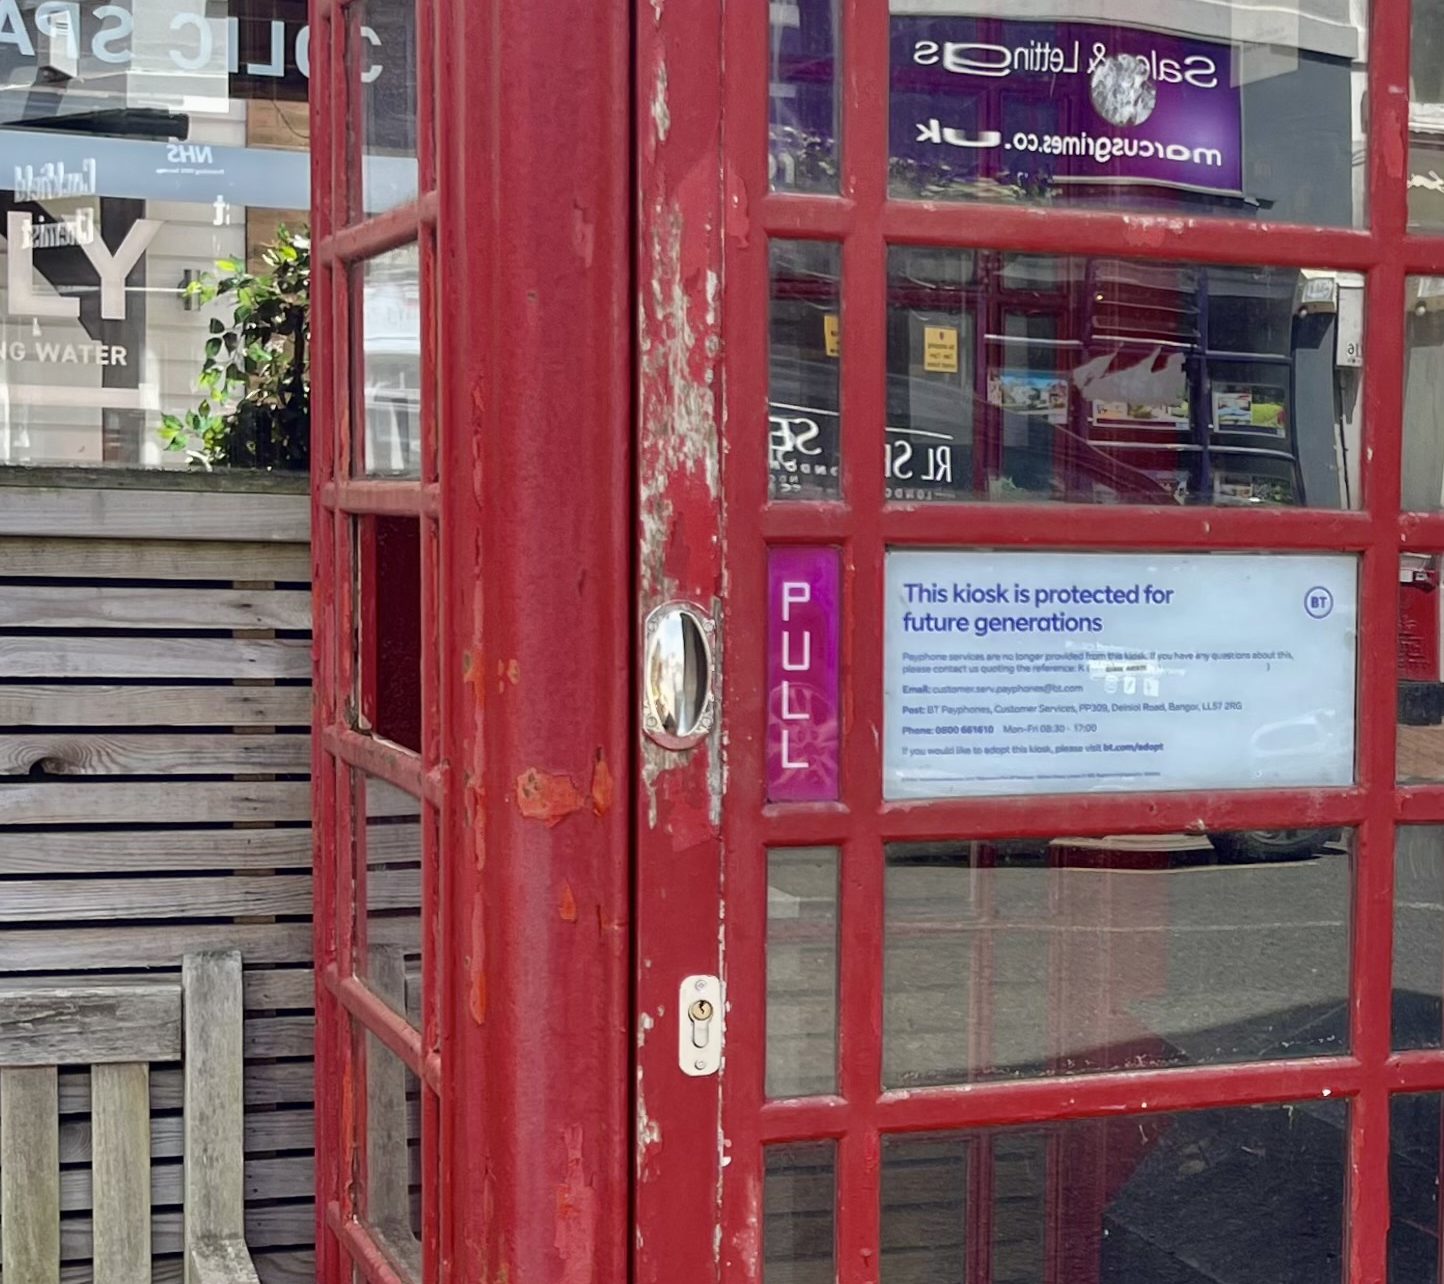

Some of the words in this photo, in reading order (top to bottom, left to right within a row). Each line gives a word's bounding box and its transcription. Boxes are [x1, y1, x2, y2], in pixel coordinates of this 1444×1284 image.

[36, 343, 128, 366] WATER
[903, 583, 948, 604] This
[953, 583, 1010, 604] kiosk
[1014, 583, 1031, 604] is
[1034, 584, 1140, 608] protected
[1144, 585, 1174, 604] for
[1310, 596, 1328, 609] BT
[903, 612, 970, 632] future
[974, 612, 1103, 637] generations
[902, 652, 947, 663] Payphone
[949, 652, 985, 661] services
[1015, 652, 1044, 663] longer
[1045, 652, 1084, 663] provided
[1086, 652, 1107, 661] from
[1107, 652, 1123, 661] this
[1157, 653, 1173, 663] you
[1174, 652, 1193, 661] have
[1195, 654, 1210, 663] any
[1211, 652, 1251, 662] questions
[1252, 652, 1276, 661] about
[782, 582, 811, 768] PULL
[902, 664, 932, 675] please
[933, 664, 968, 673] contact
[968, 665, 979, 673] us
[980, 664, 1015, 675] quoting
[1016, 663, 1031, 673] the
[902, 684, 931, 694] Email:
[902, 705, 926, 715] Post:
[927, 704, 939, 714] BT
[941, 704, 993, 716] Payphones,
[994, 703, 1037, 714] Customer
[1038, 703, 1078, 715] Services,
[1142, 702, 1167, 712] Road,
[1168, 702, 1200, 713] Bangor,
[1201, 702, 1223, 711] LL57
[1224, 701, 1243, 711] 2RG
[902, 726, 933, 735] Phone:
[935, 726, 960, 735] 0800
[1073, 723, 1097, 733] 17:00
[909, 748, 926, 757] you
[927, 746, 955, 755] would
[956, 746, 971, 755] like
[973, 746, 983, 754] to
[984, 745, 1010, 756] adopt
[1012, 745, 1027, 754] this
[1055, 744, 1084, 755] please
[1085, 743, 1102, 753] visit
[1103, 742, 1164, 753] bt.com/adopt
